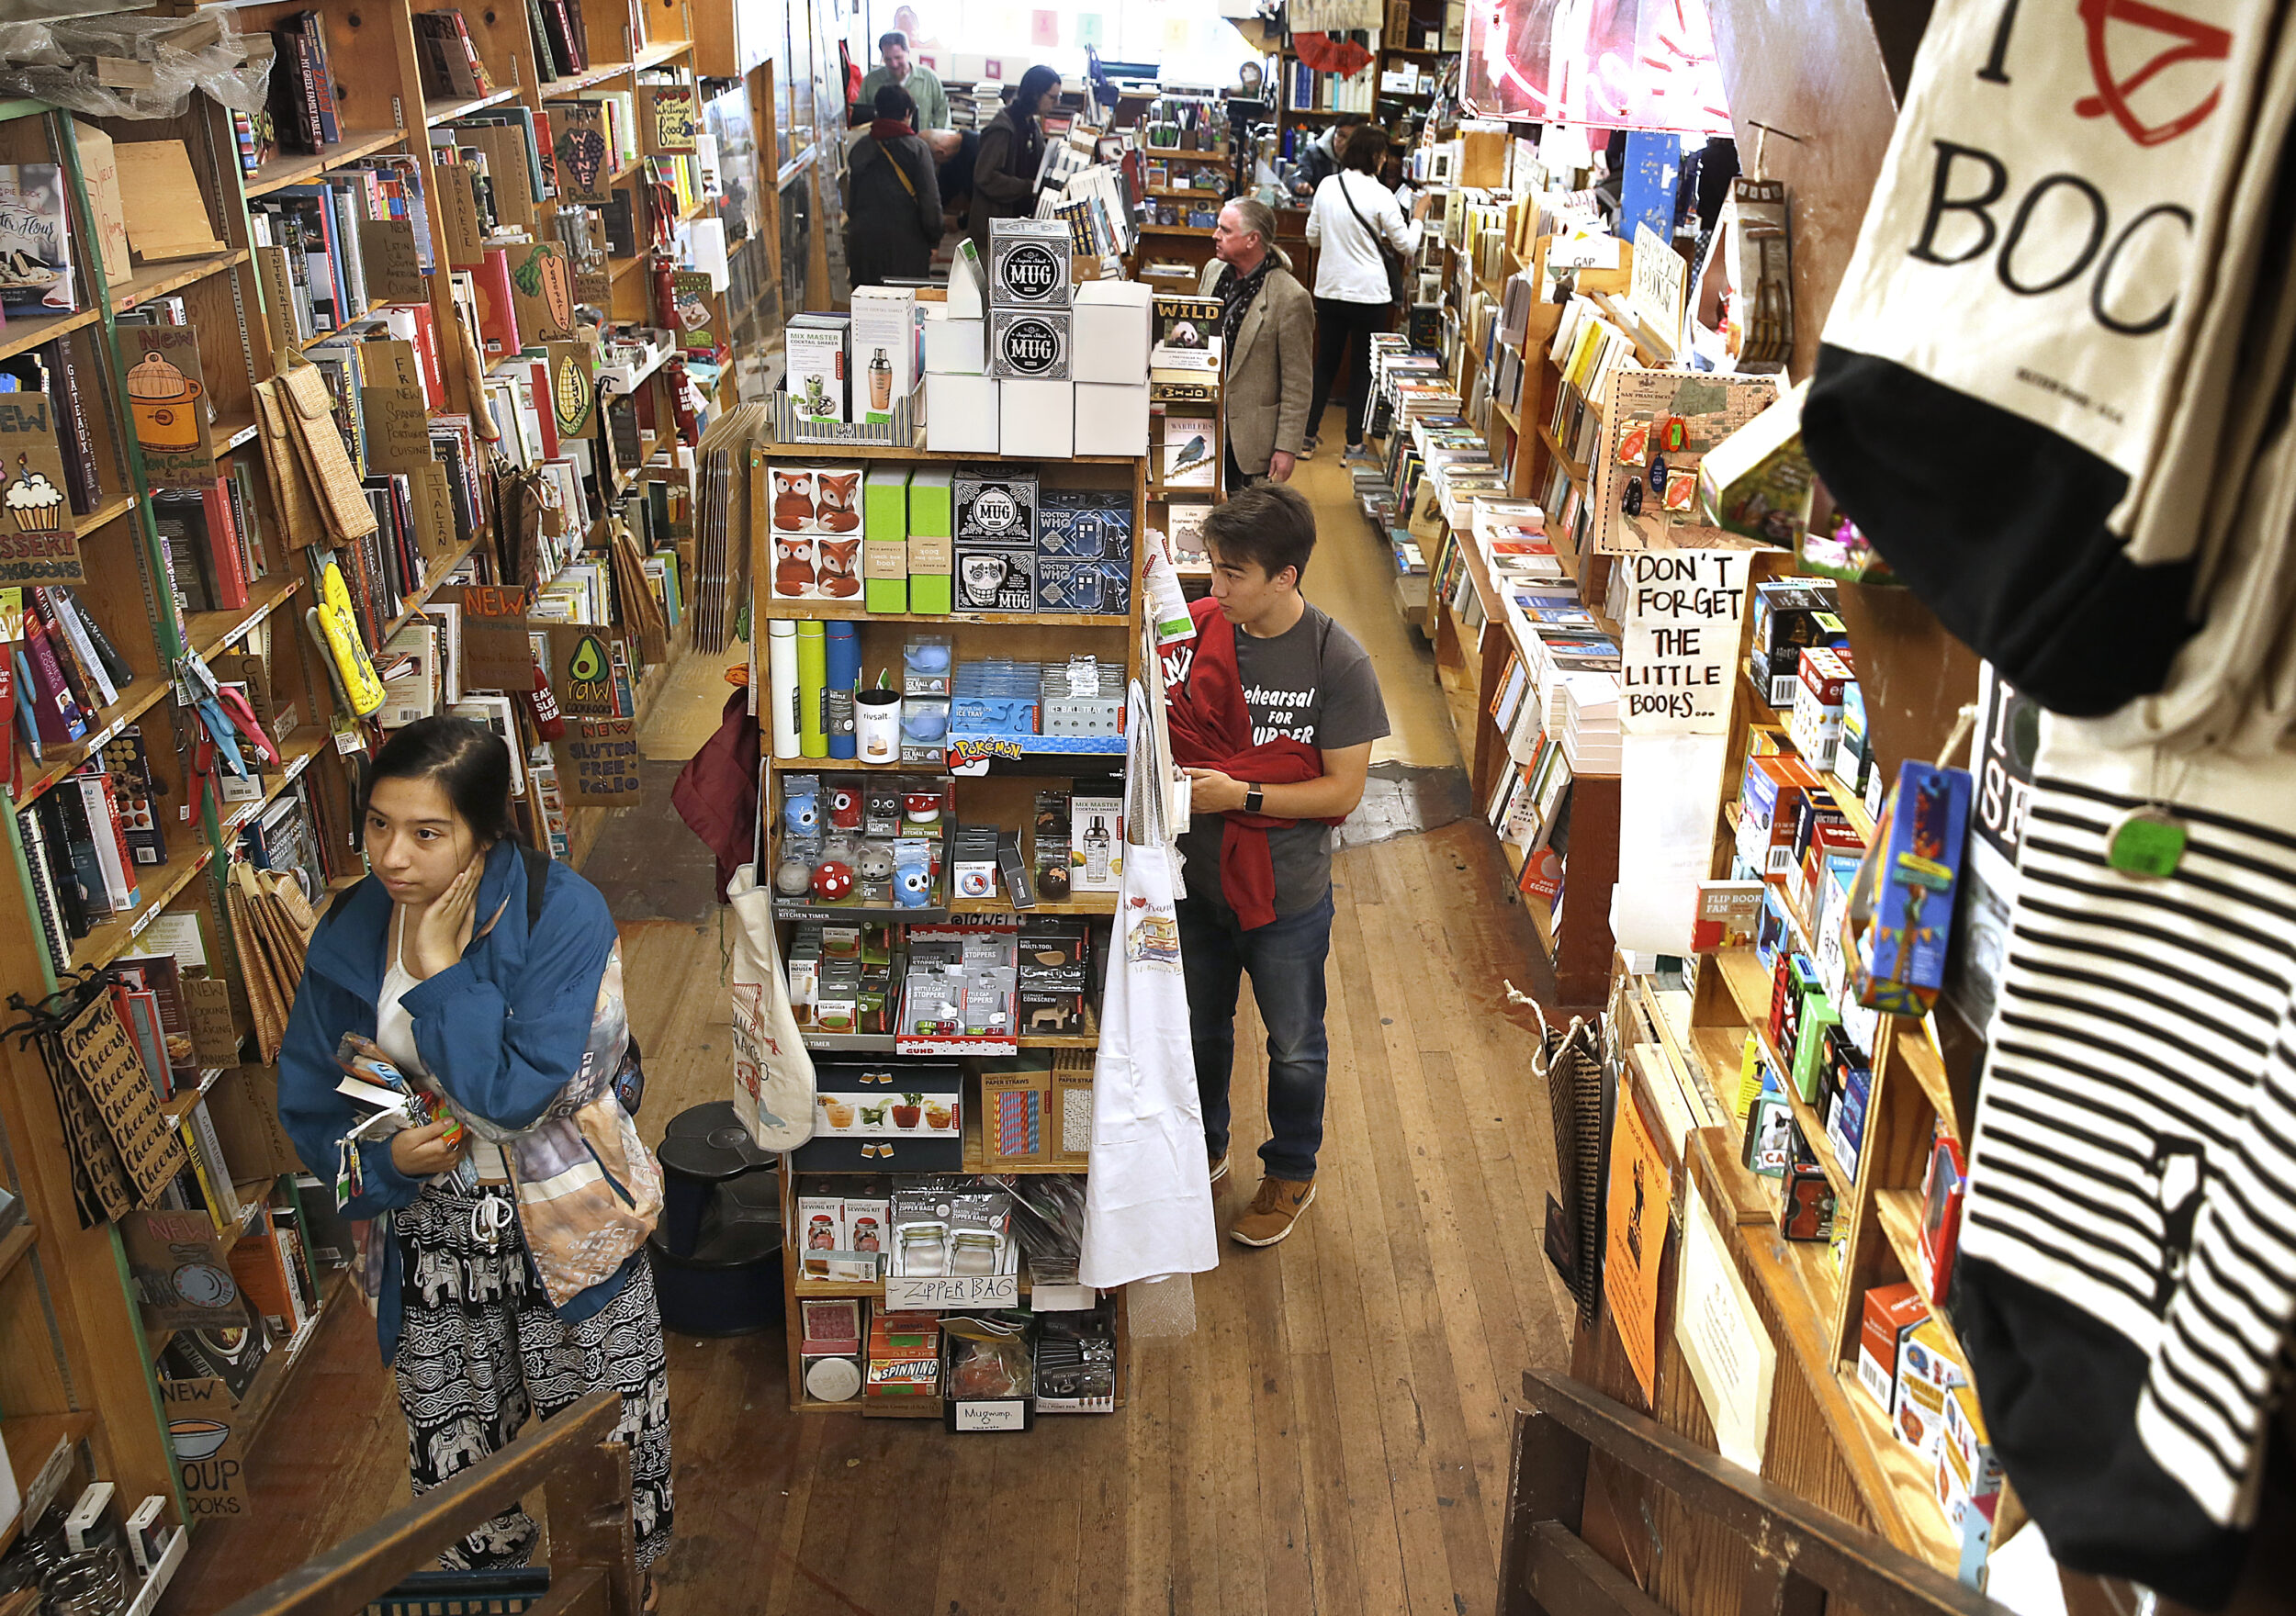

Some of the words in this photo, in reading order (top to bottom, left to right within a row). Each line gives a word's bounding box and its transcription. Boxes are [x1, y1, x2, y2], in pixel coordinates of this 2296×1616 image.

[1976, 0, 2021, 84] I
[303, 70, 313, 93] GREEK
[312, 69, 332, 112] ZAHAV
[307, 93, 317, 113] FAMILY
[310, 114, 321, 136] TABLE
[565, 109, 599, 121] NEW
[659, 119, 685, 145] food
[20, 189, 41, 198] BOOK
[451, 167, 472, 247] JAPANESE
[390, 222, 411, 233] NEW
[384, 239, 410, 252] LATIN
[1573, 257, 1595, 266] GAP
[1010, 264, 1052, 285] MUG
[388, 285, 420, 295] CUISINE
[1157, 303, 1220, 320] WILD
[138, 330, 194, 351] New
[1010, 338, 1052, 359] MUG
[432, 355, 441, 385] SCHOOL
[396, 389, 420, 400] NEW
[1165, 387, 1204, 398] WILD
[67, 364, 89, 454] GATEAUX
[386, 401, 425, 421] SPANISH
[1171, 422, 1213, 431] WARBLERS
[390, 446, 429, 457] CUISINE
[426, 474, 447, 546] ITALIAN
[980, 505, 1011, 520] MUG
[1041, 519, 1071, 528] WHO
[1041, 570, 1071, 580] WHO
[1637, 554, 1733, 588] DON'T
[166, 562, 181, 612] KOMBUCHA
[464, 587, 524, 616] NEW
[998, 593, 1030, 608] MUG
[1638, 588, 1743, 621] FORGET
[1651, 628, 1700, 657] THE
[40, 652, 58, 689] COOKIES
[47, 650, 62, 682] DORIE'S
[1625, 665, 1721, 687] LITTLE
[567, 679, 611, 701] raw
[1242, 684, 1315, 708] ehearsal
[565, 702, 613, 714] COOKBOOKS
[1629, 691, 1716, 718] BOOKS...
[863, 713, 888, 721] rivsalt
[1268, 711, 1293, 725] FOR
[1991, 679, 2015, 758] I
[582, 721, 632, 738] NEW
[1250, 715, 1314, 746] URDER
[338, 736, 356, 746] UTENSIL
[568, 740, 637, 759] GLUTEN
[580, 760, 625, 776] FREE
[1705, 903, 1728, 914] FAN
[1707, 893, 1730, 903] FLIP
[1732, 893, 1762, 903] BOOK
[190, 982, 225, 998] NEW
[78, 1023, 129, 1082] Cheers!
[93, 1046, 140, 1105] Cheers!
[104, 1068, 151, 1128] Cheers!
[115, 1090, 161, 1149] Cheers!
[125, 1112, 170, 1173] Cheers!
[202, 1115, 224, 1175] GATHERINGS
[137, 1133, 183, 1195] Cheers!
[189, 1140, 203, 1172] SHAKE
[147, 1217, 214, 1240] NEW
[971, 1278, 1013, 1298] BAG
[881, 1360, 937, 1380] SPINNING
[160, 1381, 215, 1403] NEW
[182, 1459, 240, 1492] OUP
[188, 1497, 241, 1514] OOKS
